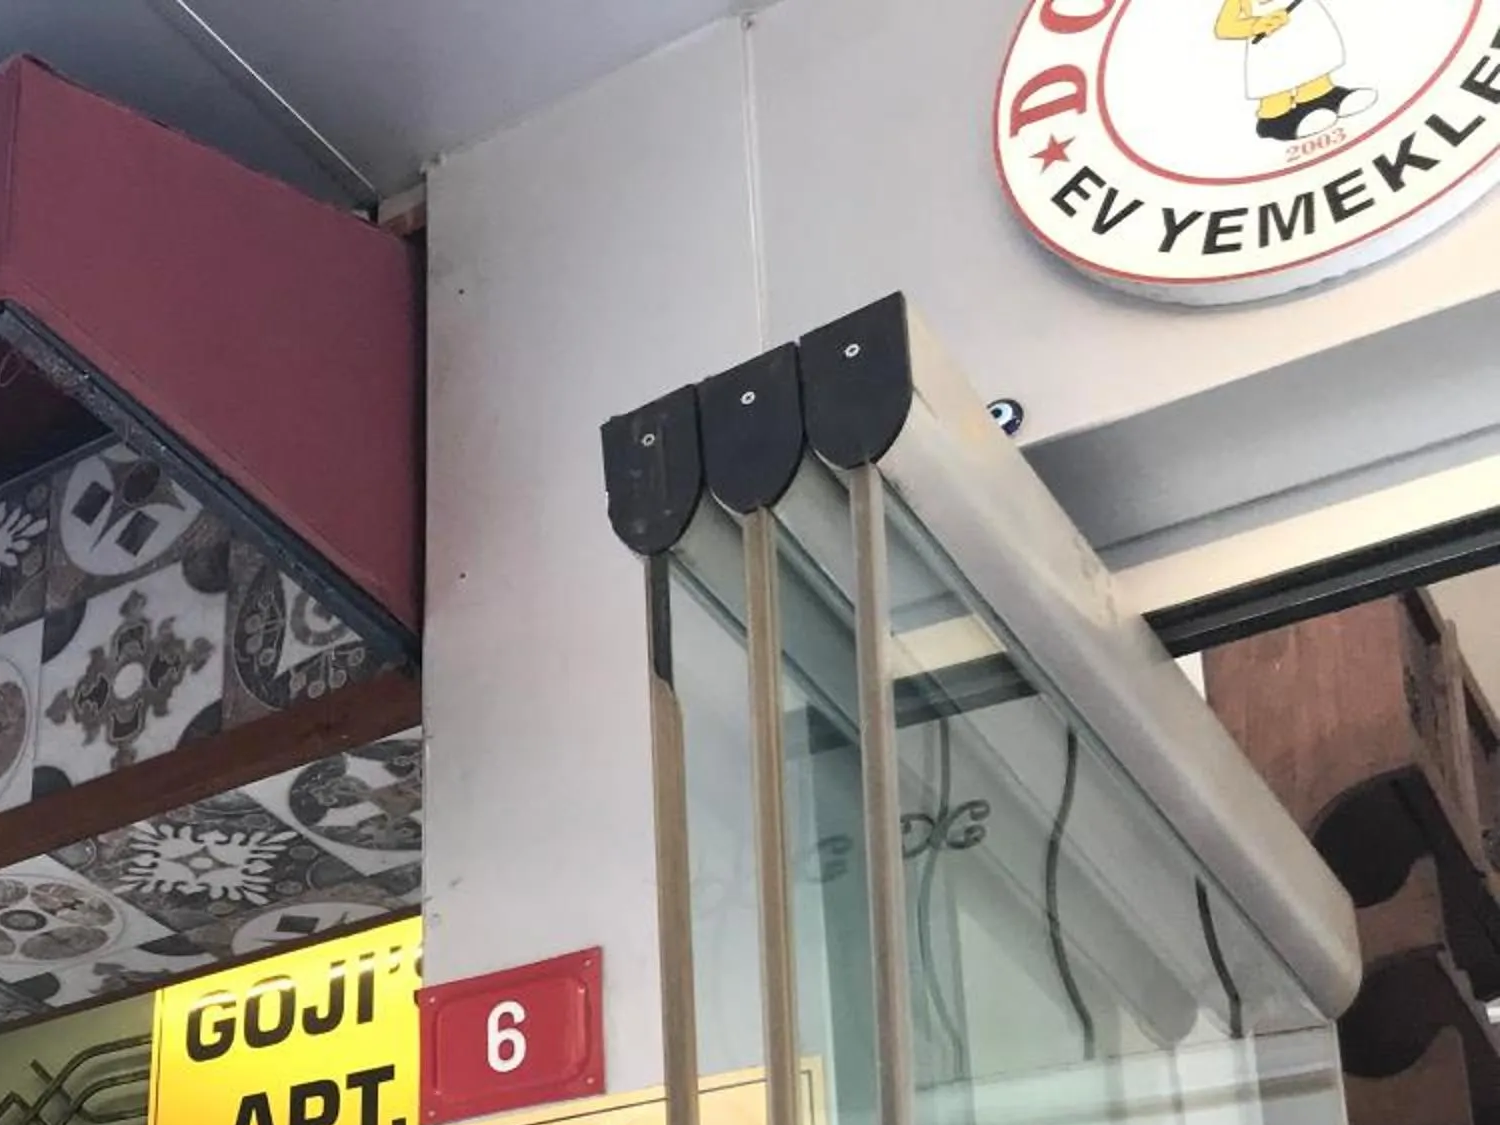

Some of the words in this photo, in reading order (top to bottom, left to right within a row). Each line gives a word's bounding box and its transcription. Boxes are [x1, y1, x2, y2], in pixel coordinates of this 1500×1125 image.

[1051, 165, 1143, 235] EV
[1158, 24, 1500, 255] YEMEKLE
[1285, 127, 1347, 163] 2003
[186, 945, 422, 1062] GOJI'
[485, 1001, 528, 1073] 6
